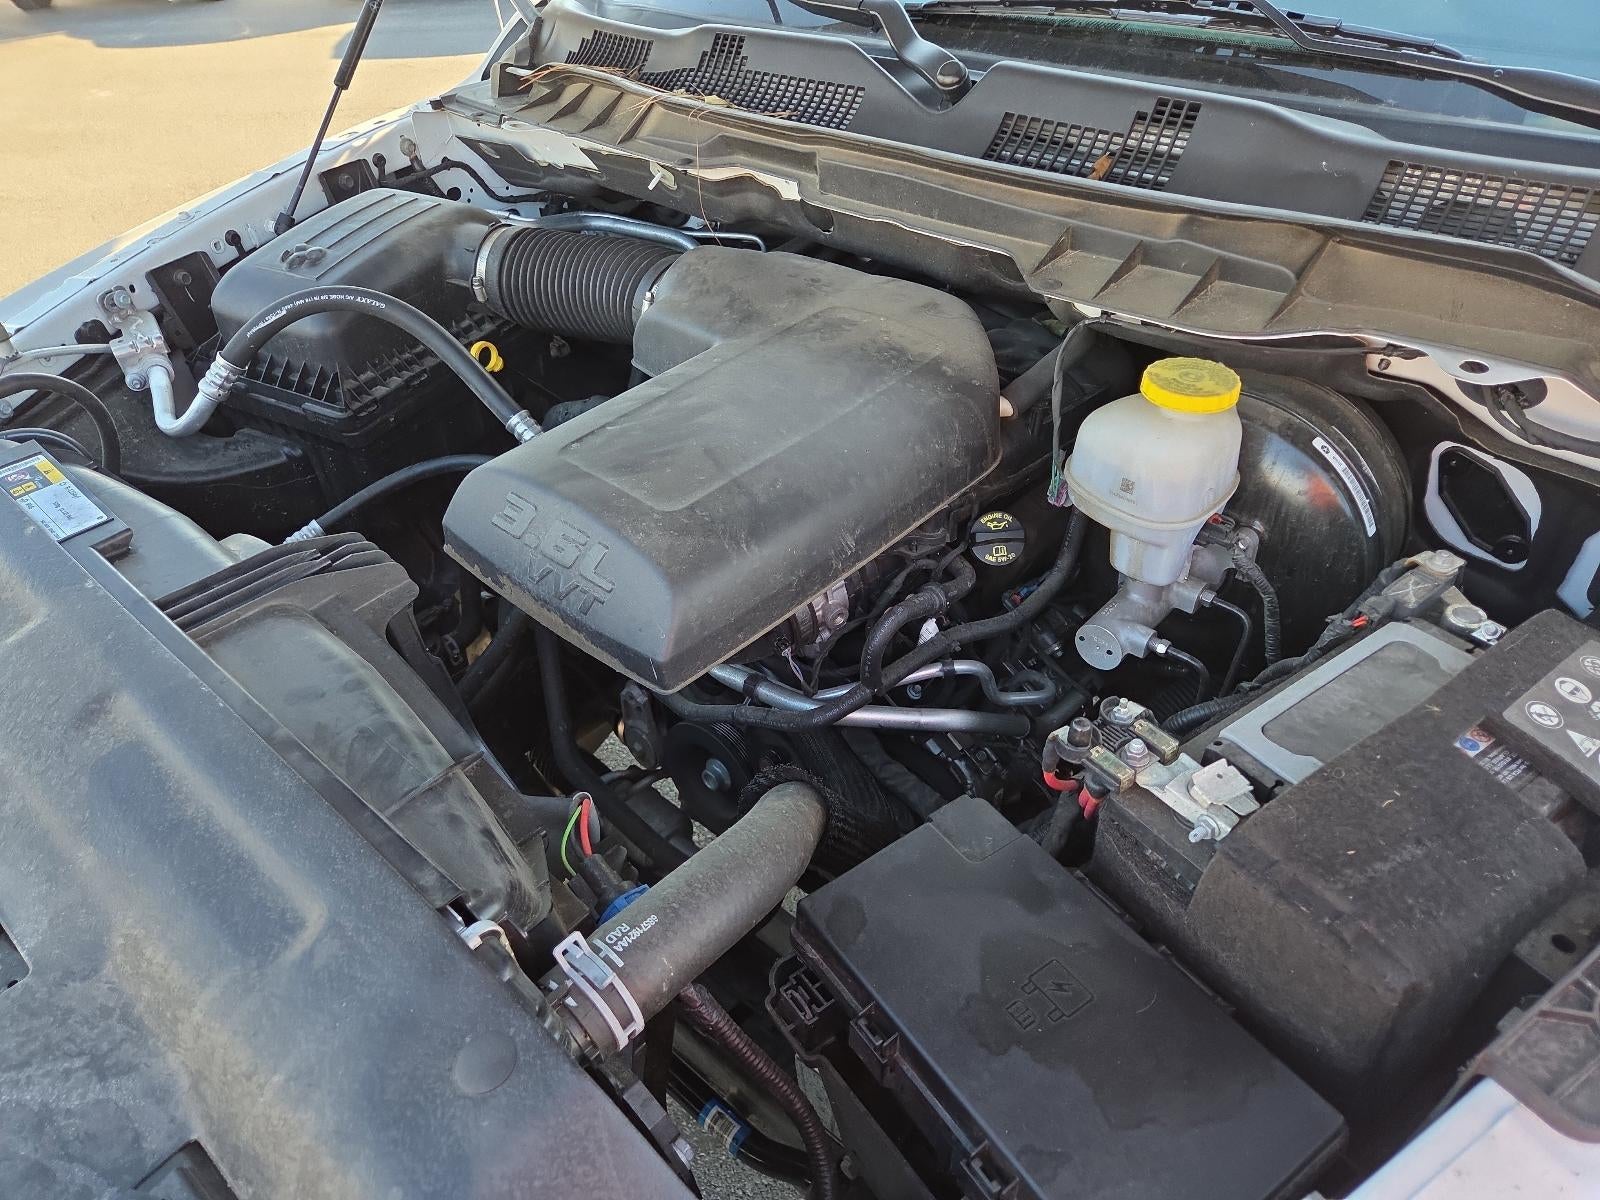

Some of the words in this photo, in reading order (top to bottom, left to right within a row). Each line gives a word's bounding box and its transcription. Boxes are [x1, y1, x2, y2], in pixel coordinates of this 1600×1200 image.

[356, 296, 386, 309] GALAXY
[980, 512, 1003, 524] ENGINE
[1003, 514, 1013, 523] OIL
[490, 491, 616, 594] 3.6L
[984, 554, 997, 562] SAE
[997, 552, 1016, 563] 5W-20
[527, 550, 606, 616] VVT
[605, 922, 631, 944] RAD
